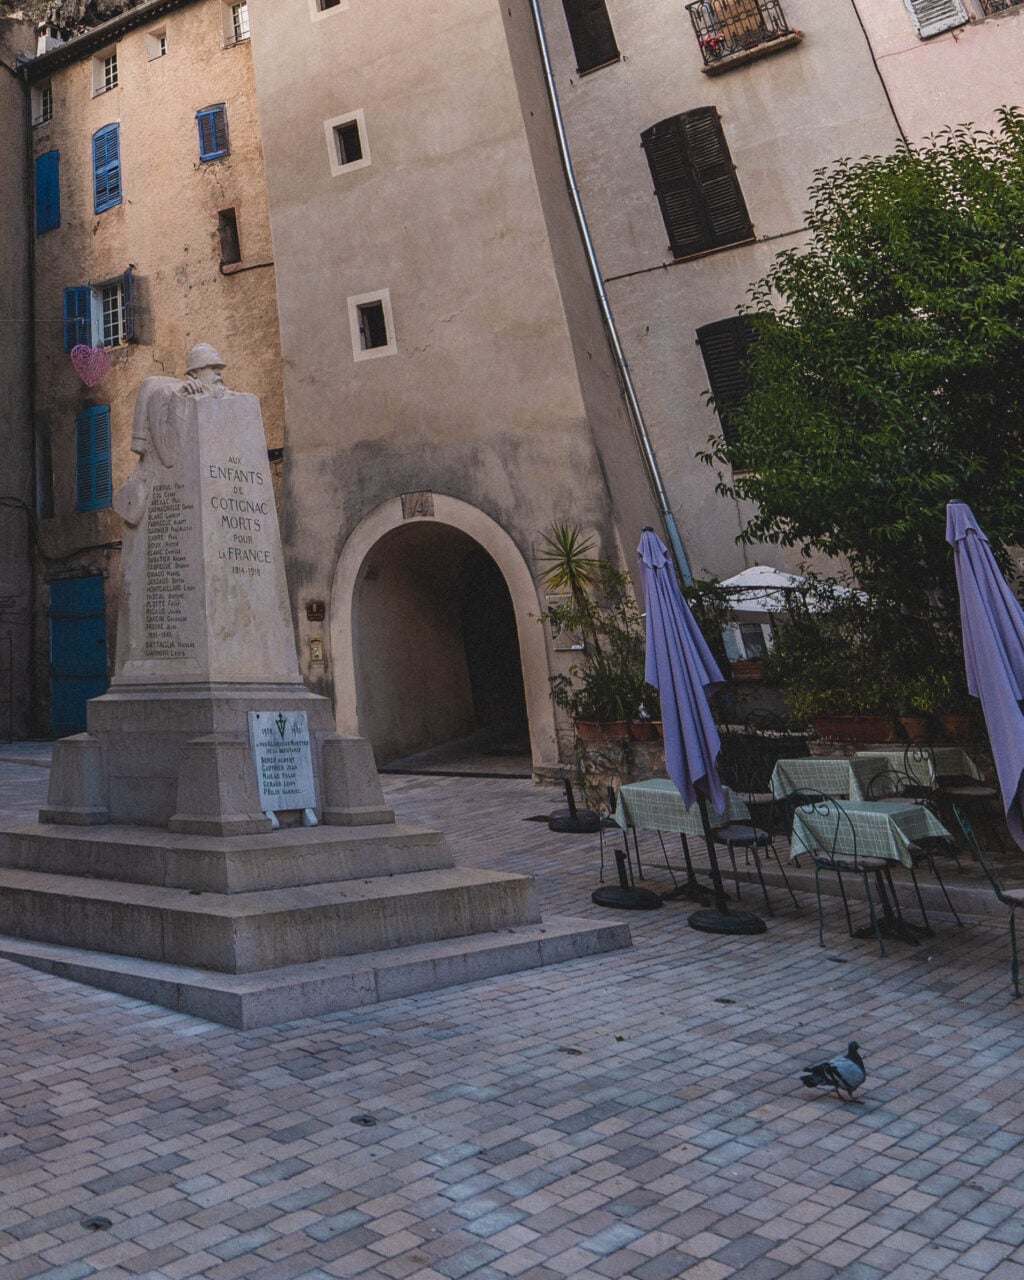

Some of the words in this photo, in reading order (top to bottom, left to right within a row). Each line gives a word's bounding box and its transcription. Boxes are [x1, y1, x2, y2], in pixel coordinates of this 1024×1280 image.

[228, 456, 242, 464] AUX
[209, 465, 264, 486] ENFANTS
[233, 486, 244, 495] DE
[211, 496, 269, 516] COTIGNAC
[221, 515, 262, 532] MORTS
[233, 534, 253, 545] POUR
[228, 547, 272, 564] FRANCE
